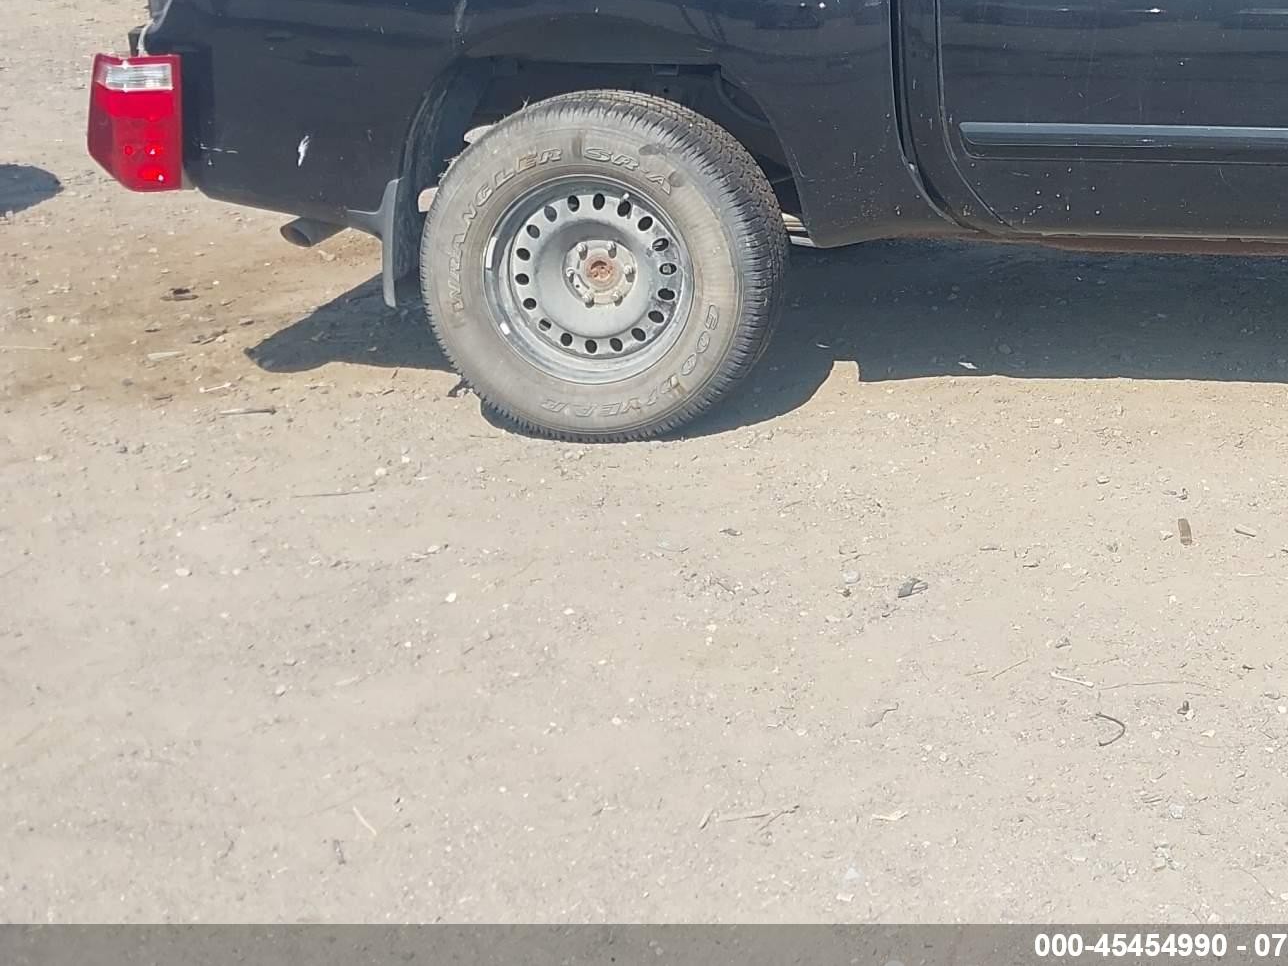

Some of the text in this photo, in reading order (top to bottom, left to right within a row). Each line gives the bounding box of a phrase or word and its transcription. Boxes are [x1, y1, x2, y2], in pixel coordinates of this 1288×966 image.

[448, 146, 672, 314] WRANGLER SR-A
[541, 305, 720, 418] GOODYEAR
